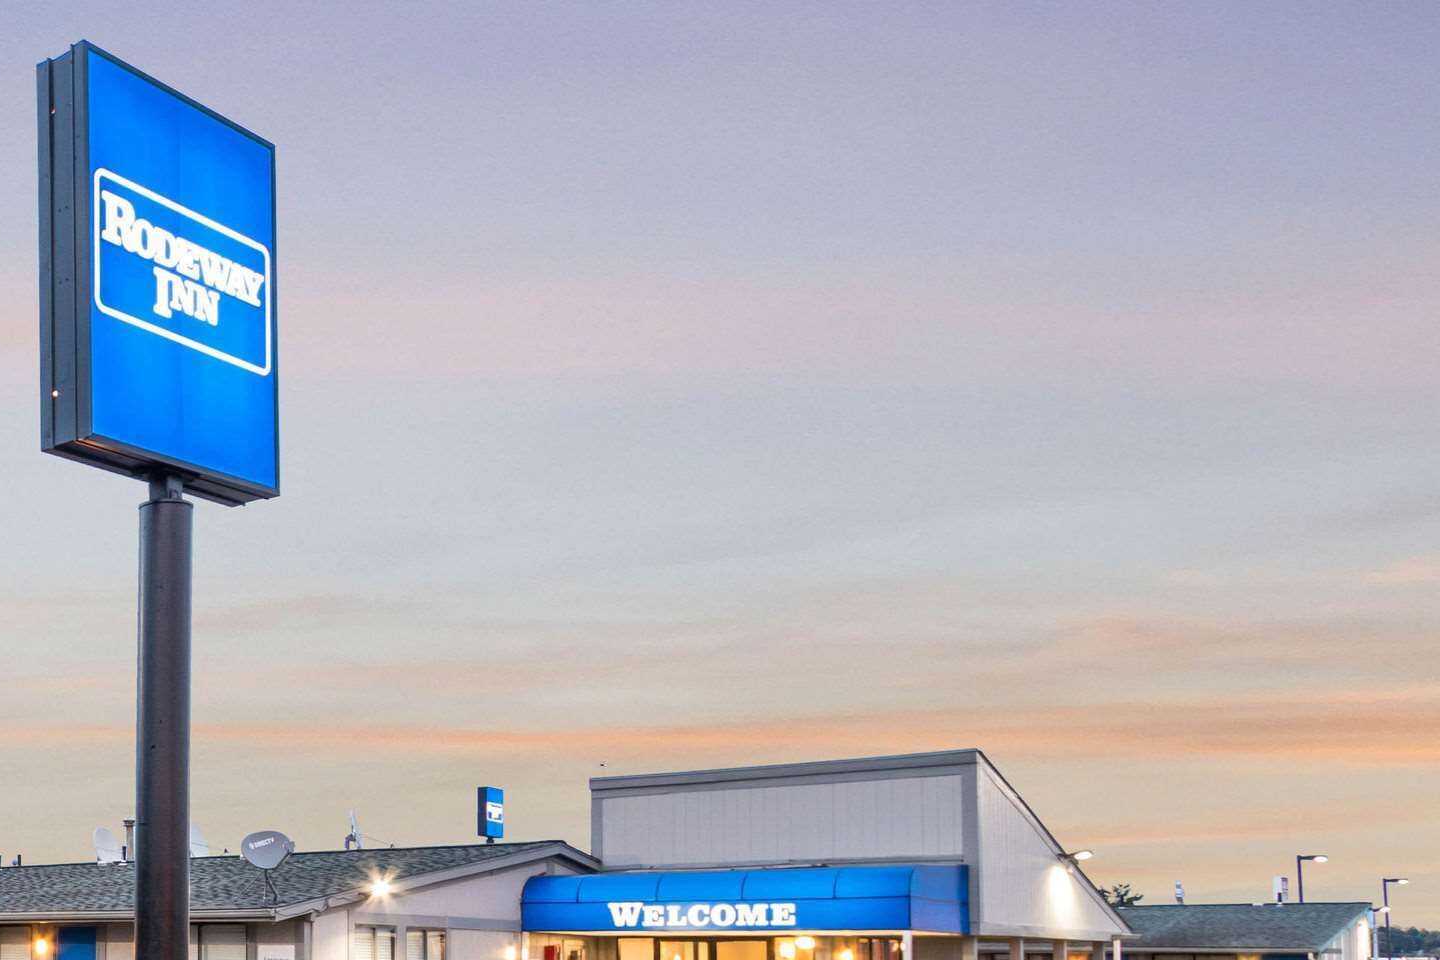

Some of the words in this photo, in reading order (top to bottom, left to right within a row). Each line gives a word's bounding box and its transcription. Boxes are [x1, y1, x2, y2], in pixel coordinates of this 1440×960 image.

[101, 190, 264, 307] RODEWAY
[153, 267, 221, 326] INN
[608, 901, 797, 928] WELCOME
